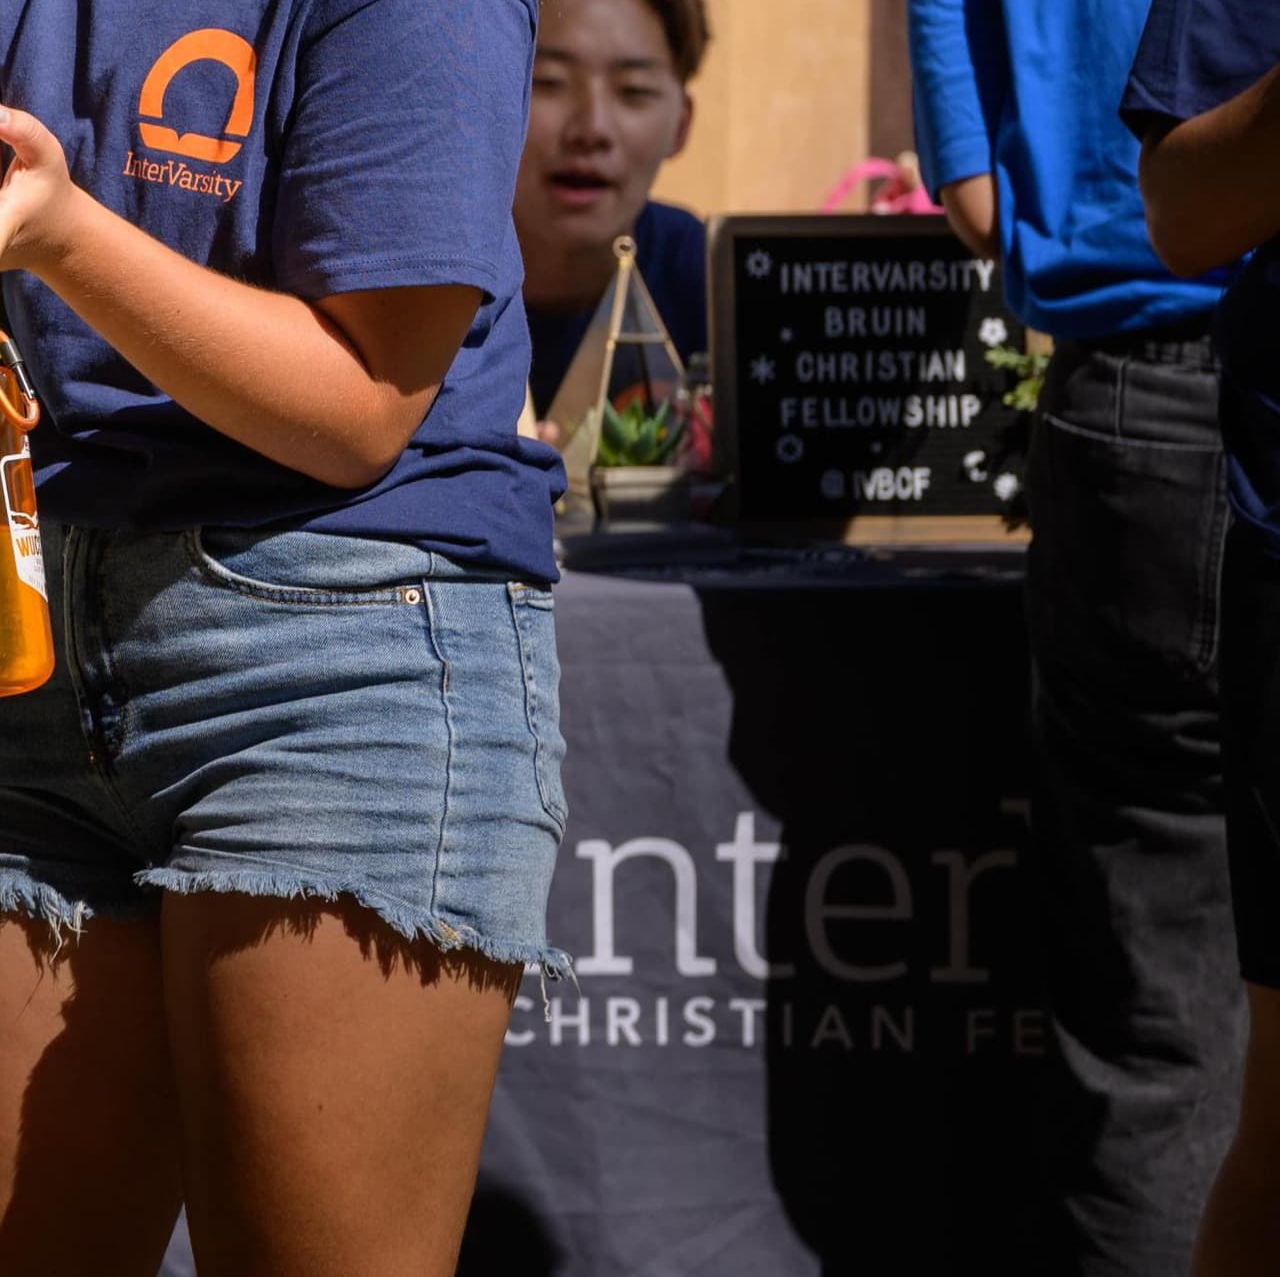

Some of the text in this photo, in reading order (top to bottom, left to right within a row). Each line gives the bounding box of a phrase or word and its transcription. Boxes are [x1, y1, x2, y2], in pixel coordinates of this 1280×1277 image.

[122, 151, 243, 203] InterVarsity
[780, 258, 995, 295] INTERVARSITY
[823, 305, 927, 338] BRUIN
[795, 348, 966, 383] CHRISTIAN
[780, 393, 982, 428] FELLOWSHIP
[524, 797, 1035, 986] nter
[502, 994, 917, 1055] CHRISTIAN
